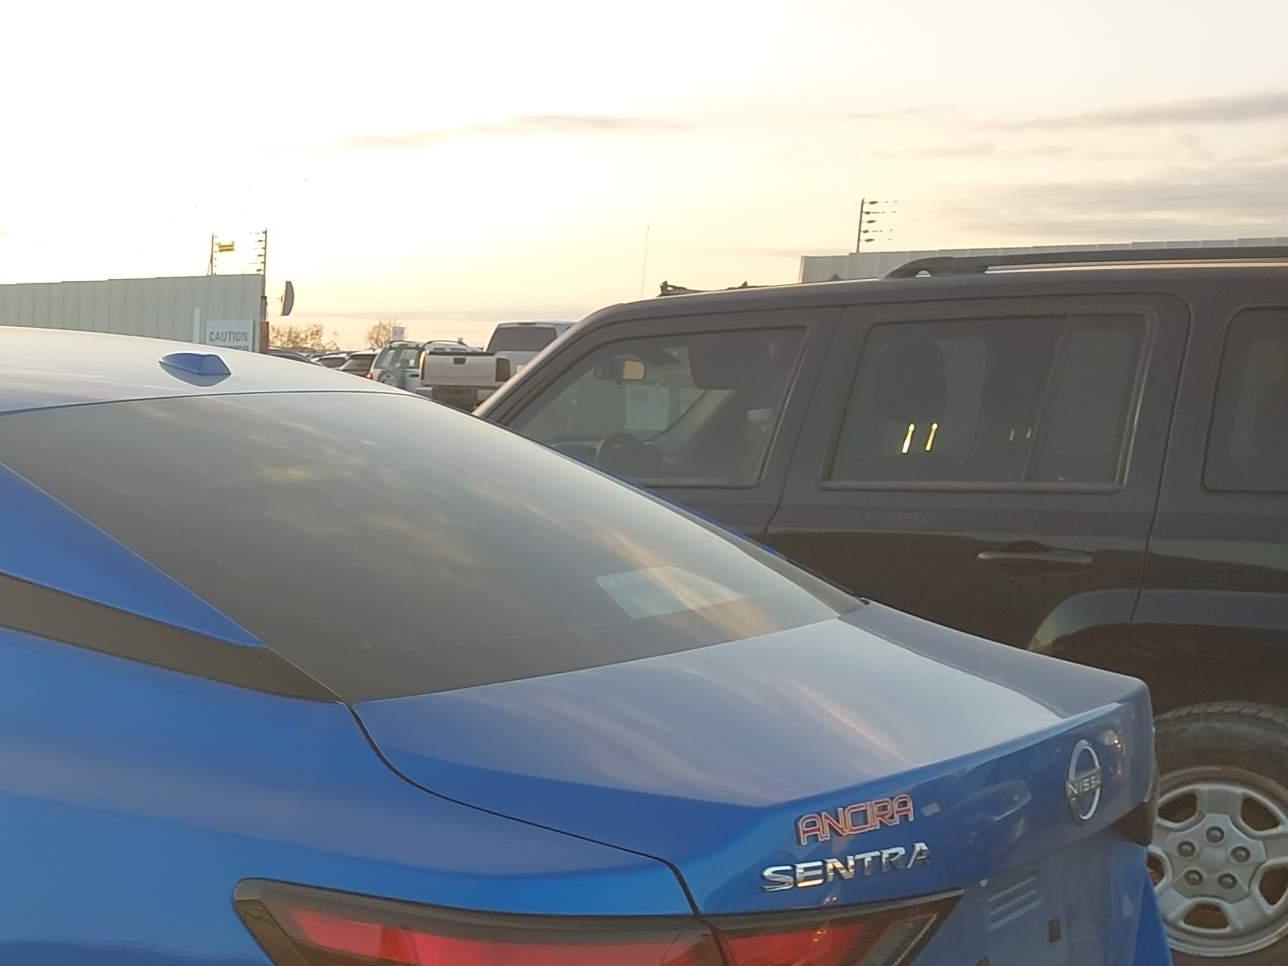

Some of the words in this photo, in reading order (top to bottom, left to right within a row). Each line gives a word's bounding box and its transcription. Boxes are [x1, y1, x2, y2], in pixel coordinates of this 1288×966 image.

[209, 331, 248, 342] CAUTION
[798, 793, 914, 846] ANCIRA
[763, 842, 930, 892] SENTRA
